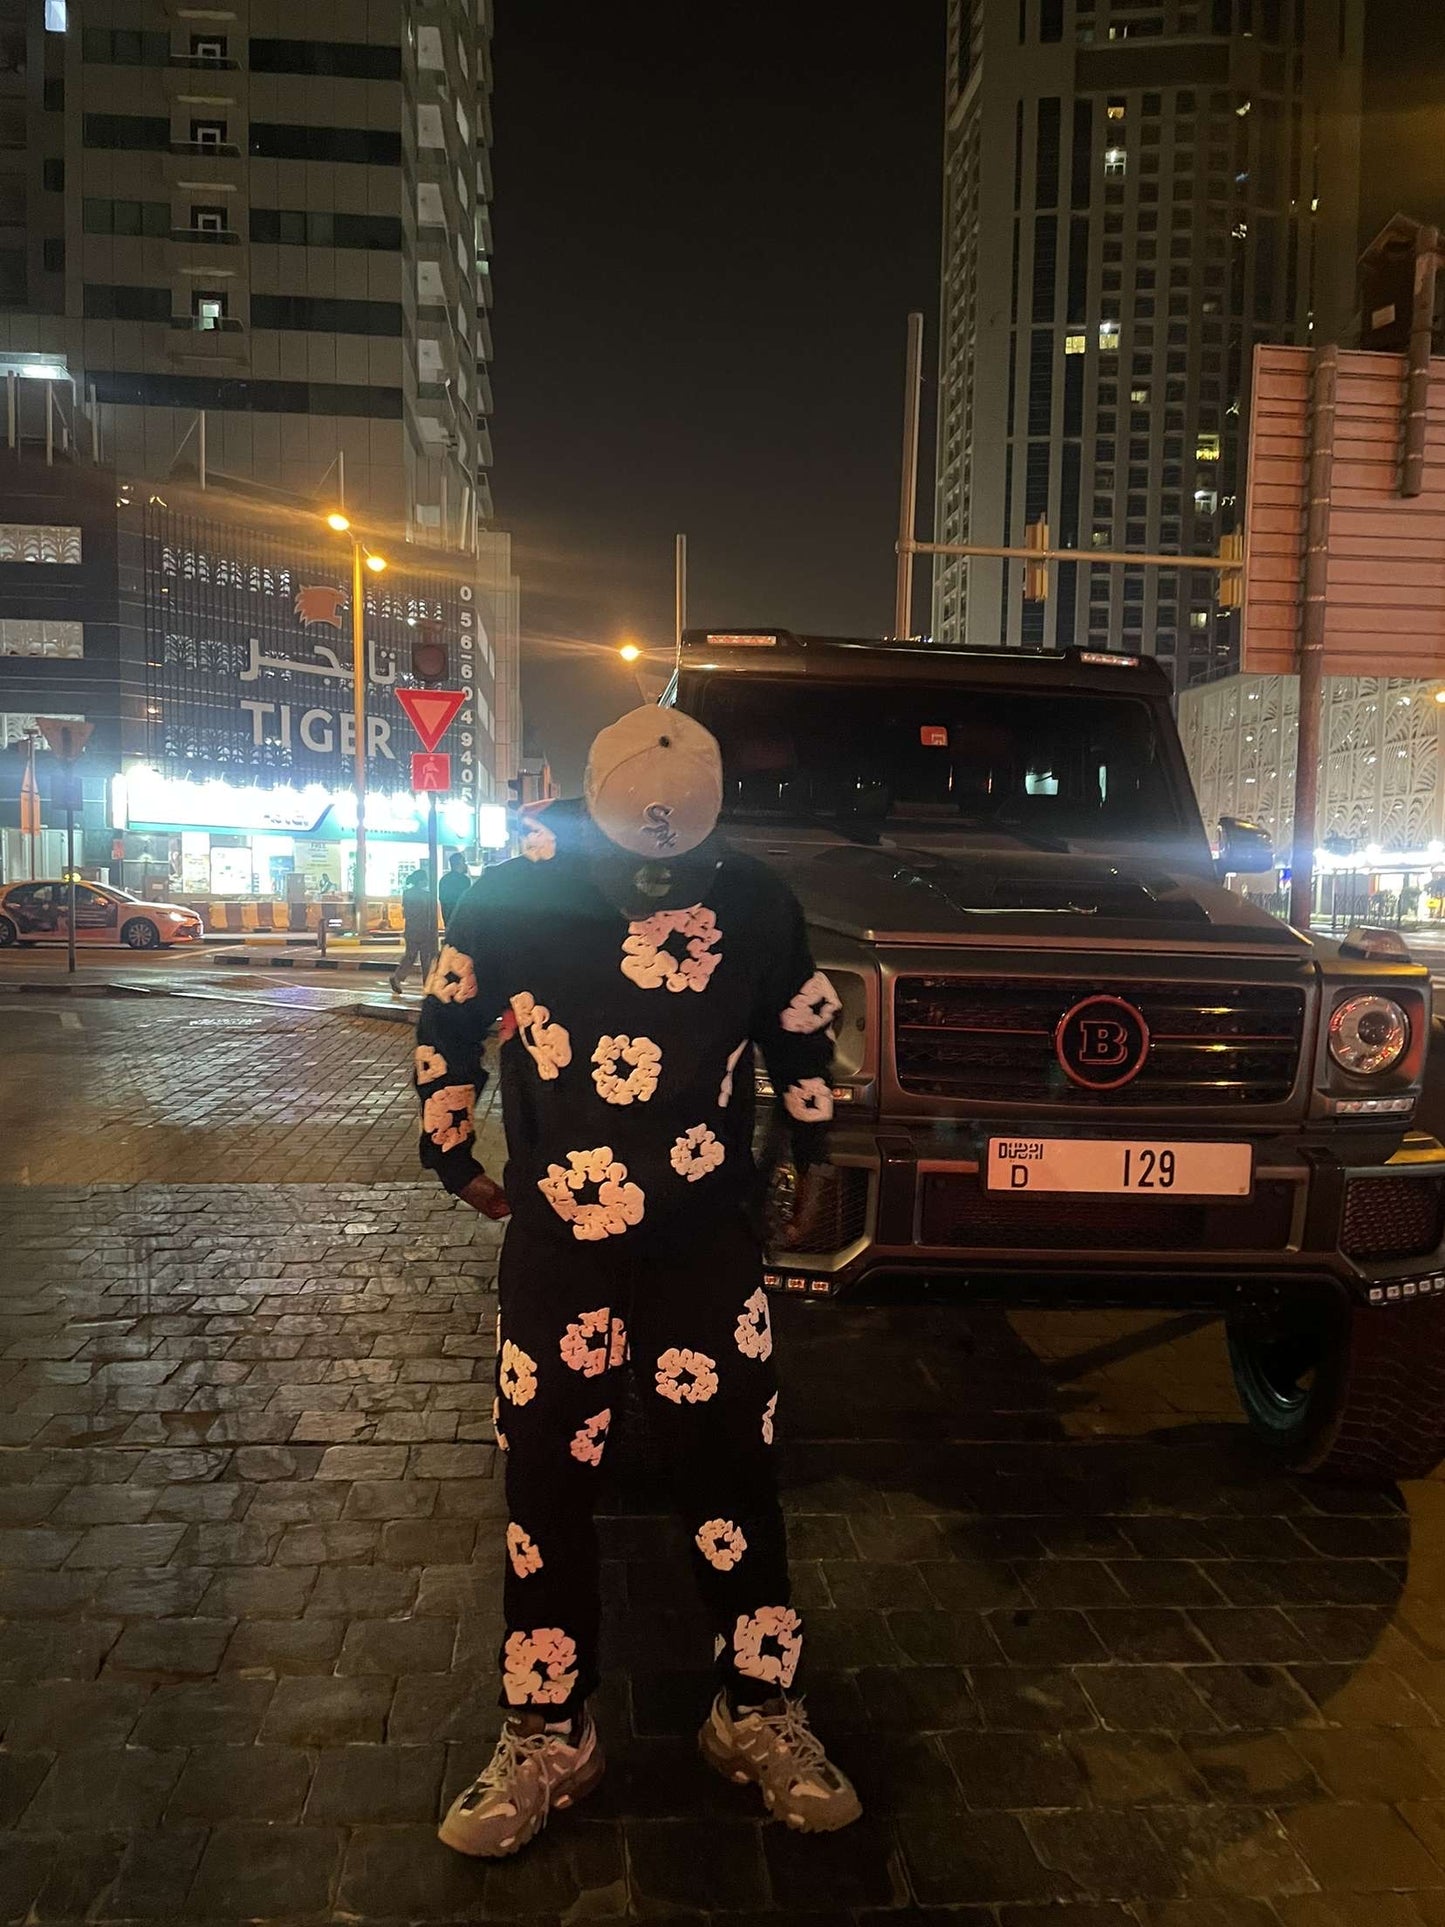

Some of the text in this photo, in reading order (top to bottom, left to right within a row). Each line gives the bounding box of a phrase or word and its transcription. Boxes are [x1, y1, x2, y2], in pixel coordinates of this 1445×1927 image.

[240, 700, 396, 760] TIGER
[1079, 1020, 1128, 1065] B
[1011, 1164, 1029, 1188] D
[1123, 1149, 1176, 1188] 129
